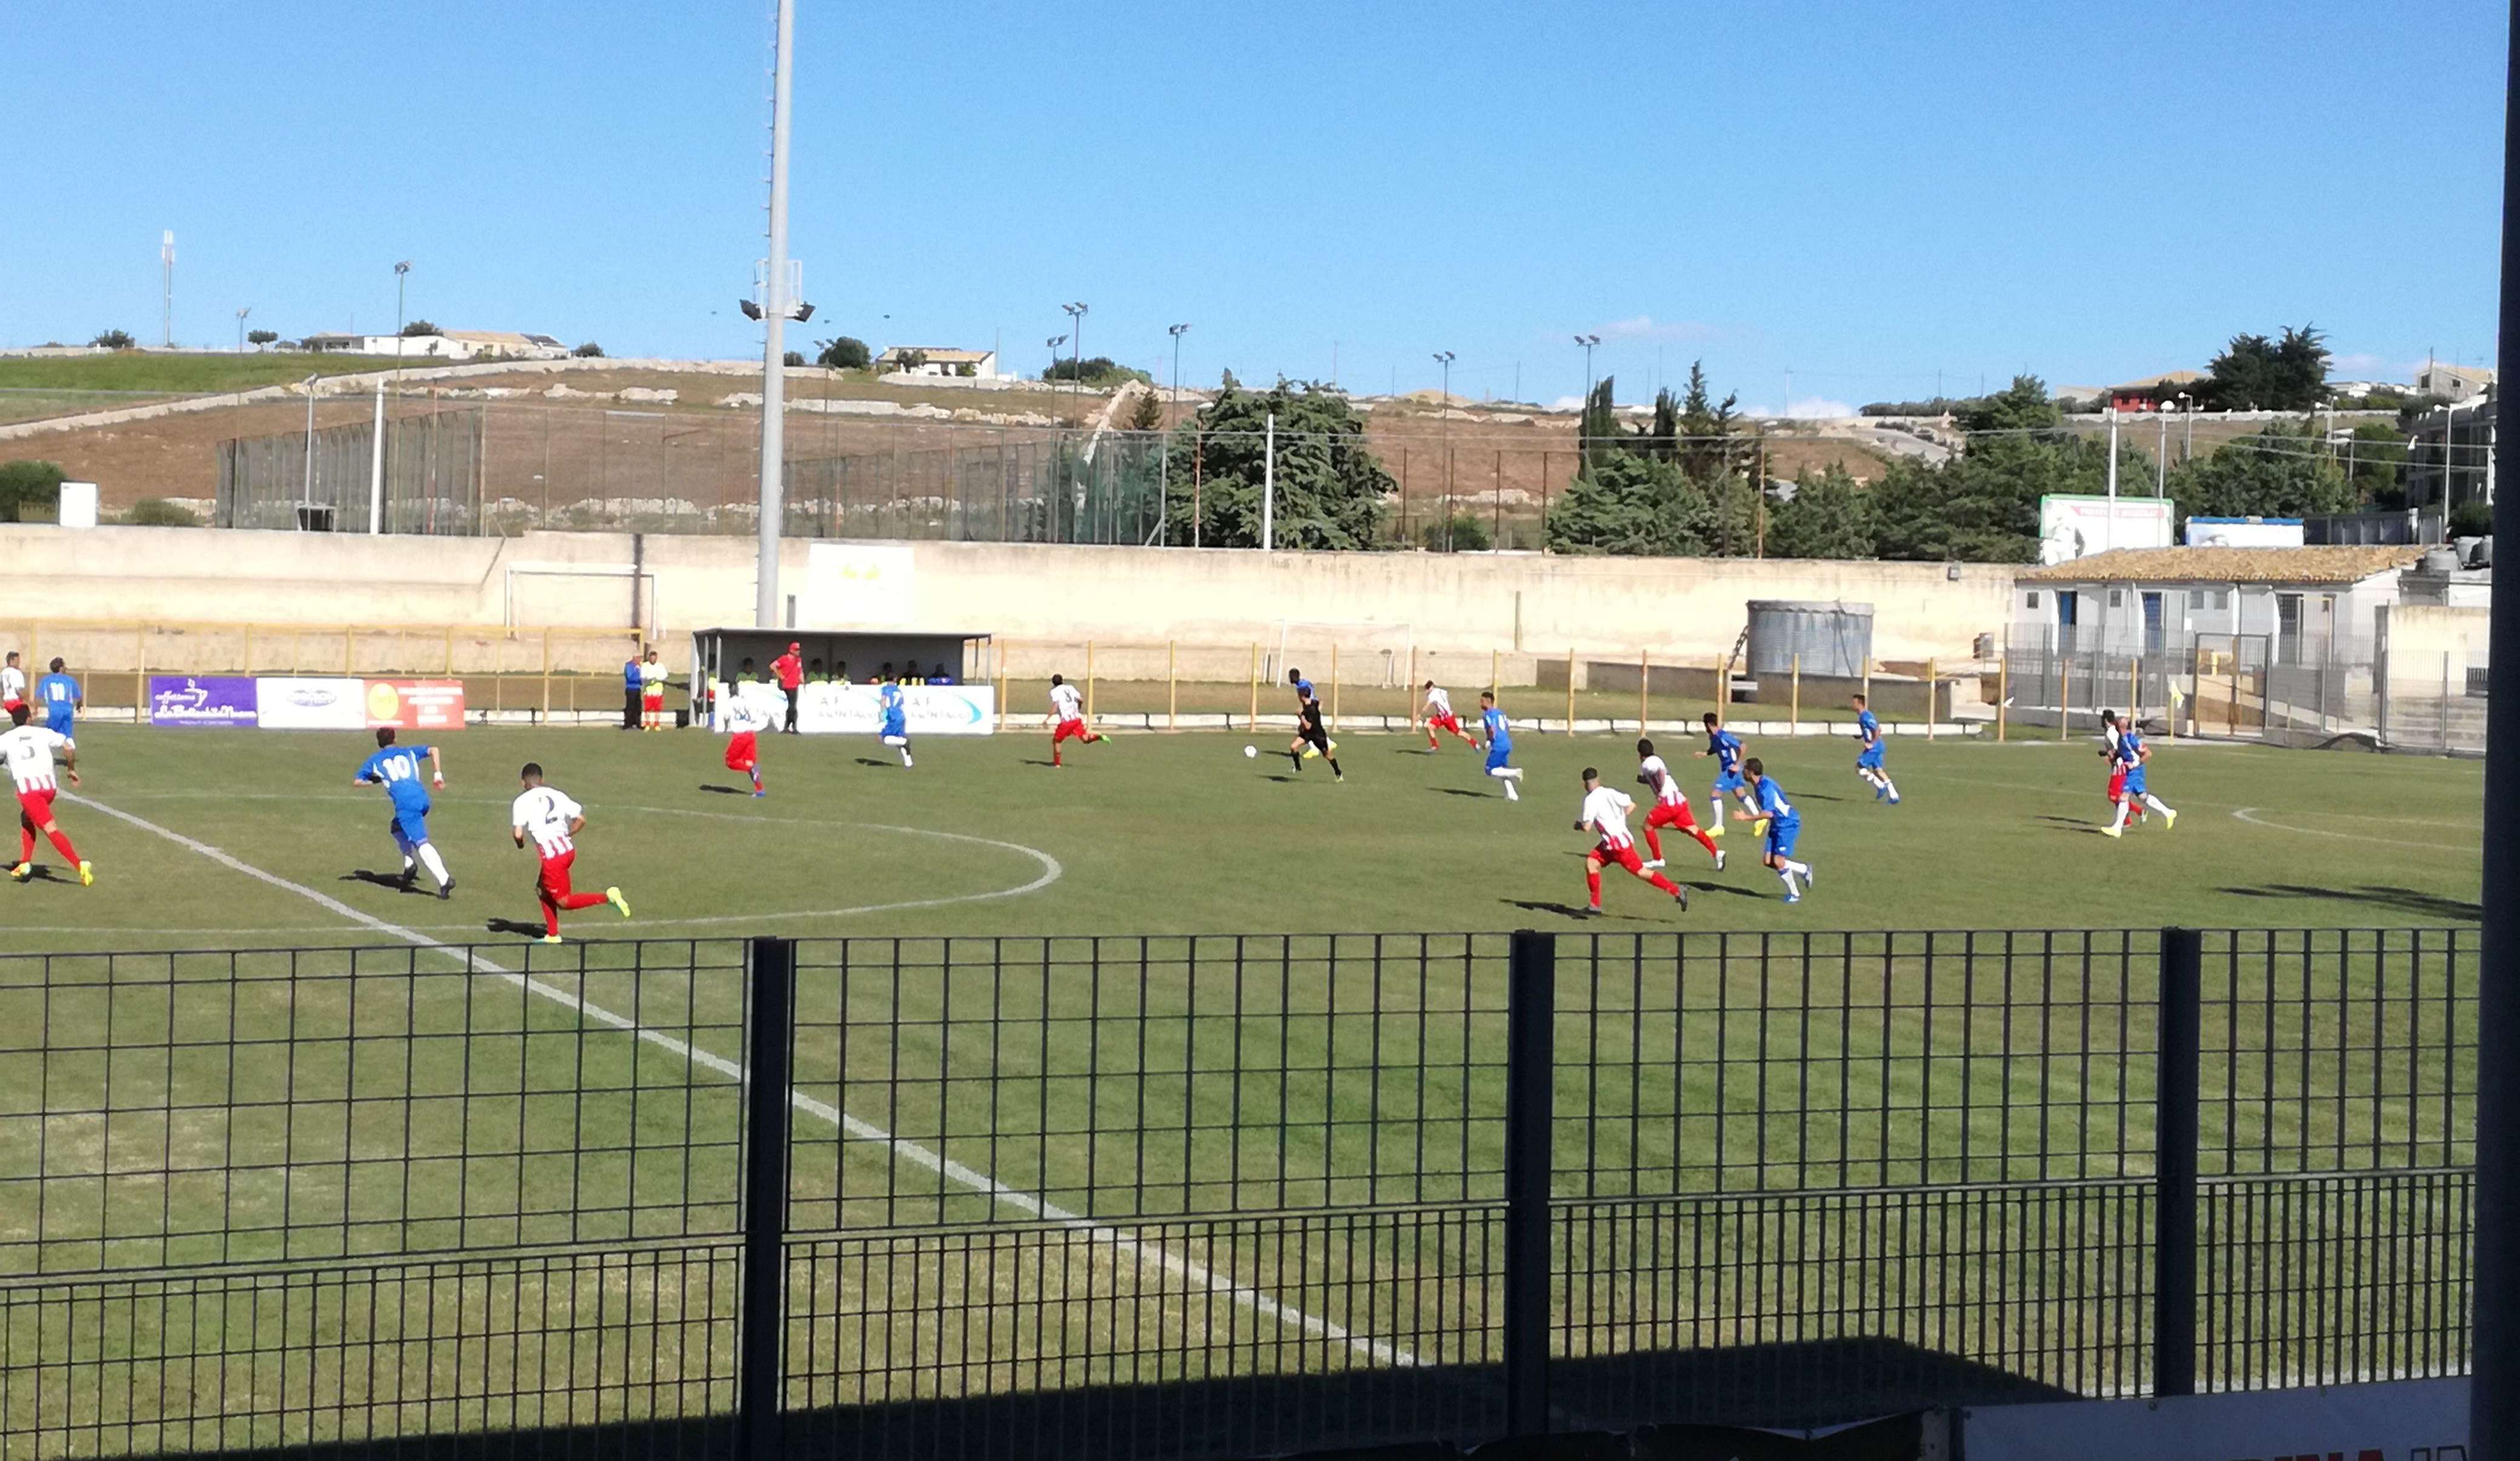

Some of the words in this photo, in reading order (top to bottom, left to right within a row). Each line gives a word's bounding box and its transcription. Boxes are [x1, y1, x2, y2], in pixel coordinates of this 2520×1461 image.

[50, 681, 65, 701] 11
[19, 735, 36, 760] 5
[382, 754, 411, 781] 10
[538, 795, 558, 825] 2
